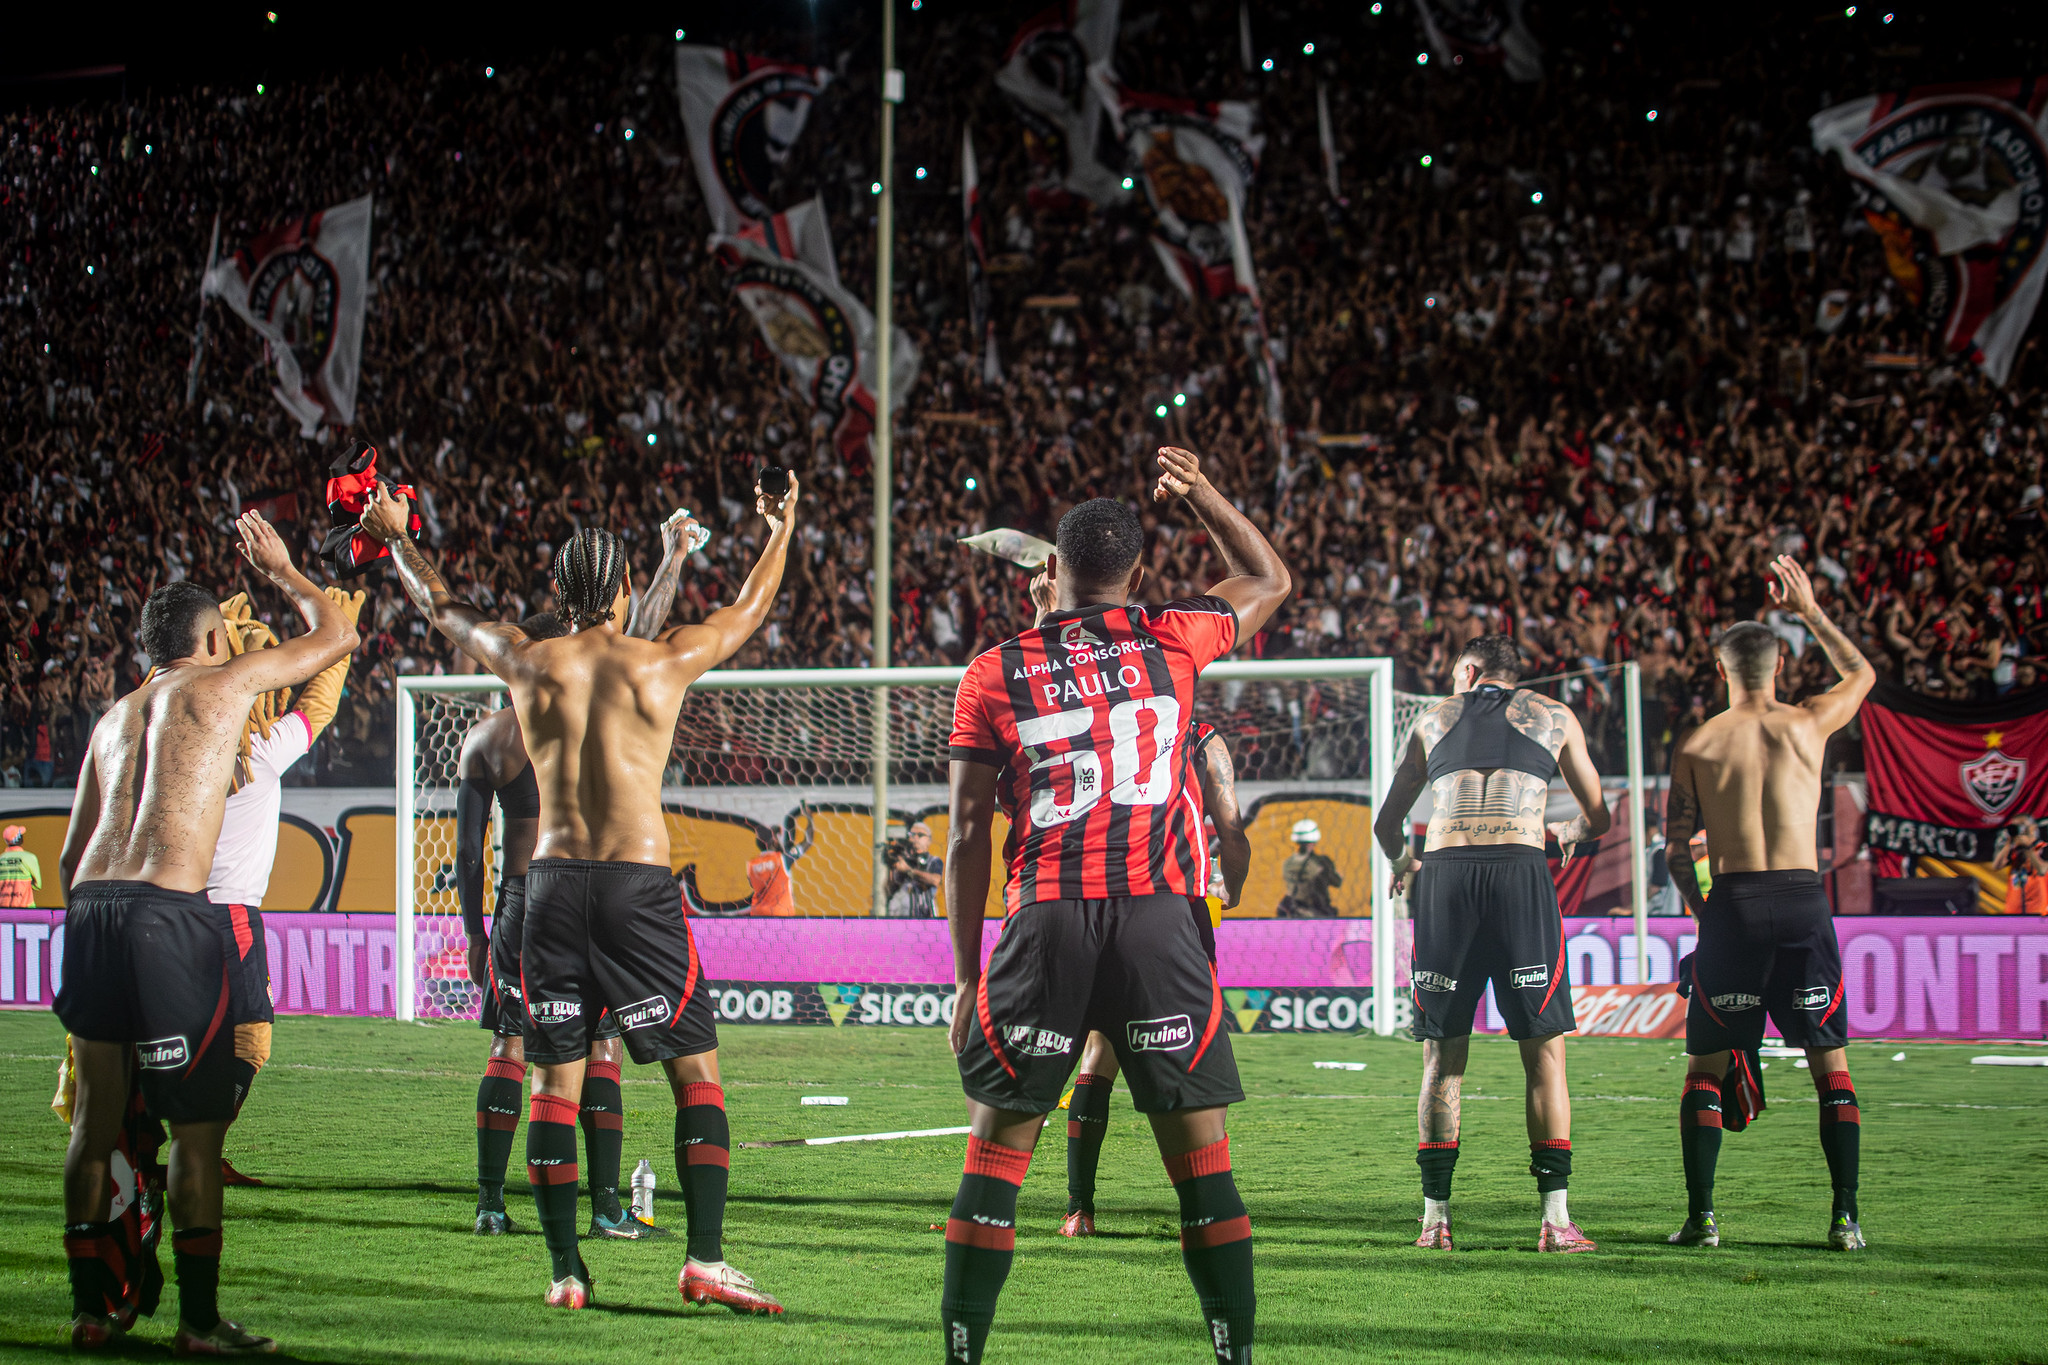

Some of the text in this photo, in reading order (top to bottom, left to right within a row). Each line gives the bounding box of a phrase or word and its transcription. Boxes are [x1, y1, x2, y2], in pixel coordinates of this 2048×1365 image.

[1013, 637, 1158, 680] ALPHA CONSÓRCIO
[1042, 664, 1142, 707] PAULO
[1016, 695, 1181, 829] 50
[1082, 767, 1095, 792] SBS
[1869, 815, 1978, 859] MARCO
[552, 1002, 582, 1016] BLUE
[1571, 987, 1678, 1036] etano
[1710, 994, 1735, 1007] VAPT
[618, 1003, 666, 1029] Iquine
[1002, 1024, 1073, 1054] VAPT BLUE
[1131, 1025, 1188, 1049] Iquine
